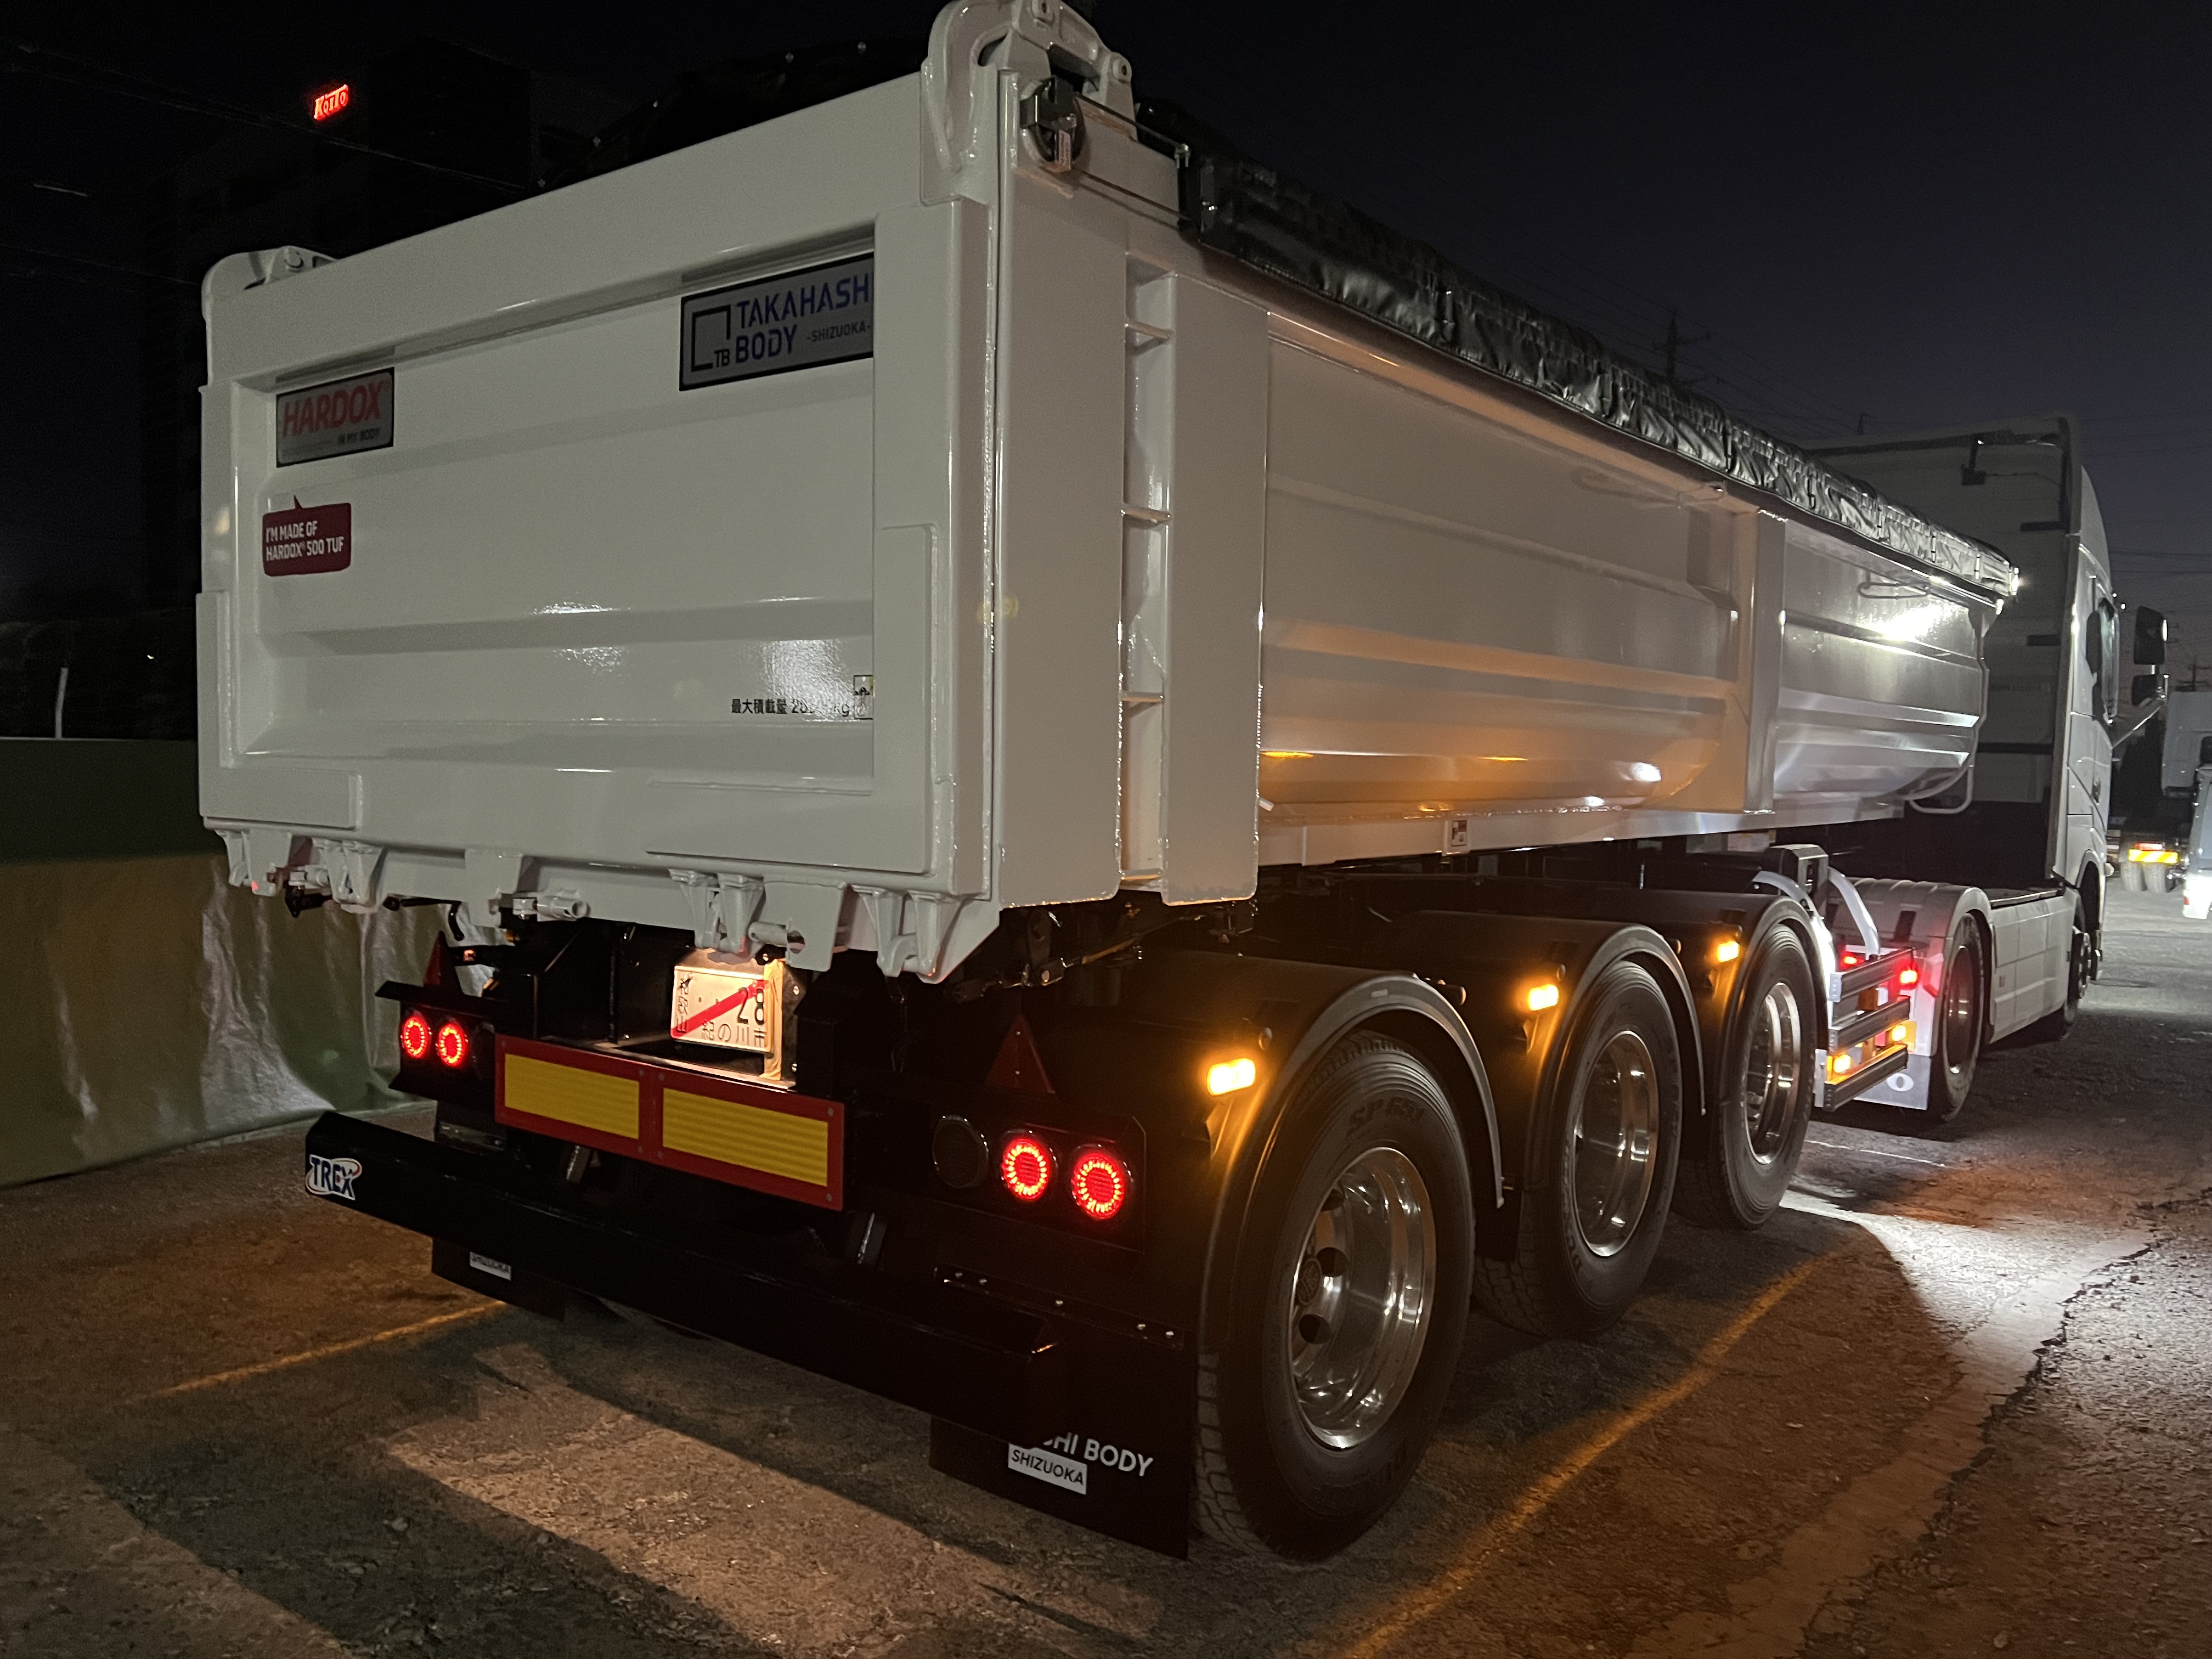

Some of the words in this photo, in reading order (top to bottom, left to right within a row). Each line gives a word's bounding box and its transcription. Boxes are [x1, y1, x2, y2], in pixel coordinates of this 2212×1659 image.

[737, 272, 868, 328] TAKAHASH
[714, 349, 730, 368] TB
[736, 324, 797, 363] BODY
[282, 381, 385, 437] HARDOX
[359, 427, 381, 442] BODY
[266, 527, 278, 543] I'M
[279, 522, 304, 540] MADE
[306, 520, 318, 536] OF
[306, 539, 325, 556] 500
[326, 536, 344, 554] TUF
[311, 1157, 353, 1198] TREX
[1011, 1449, 1084, 1486] SHIZUOKA
[1042, 1432, 1079, 1455] HI
[1084, 1438, 1154, 1477] BODY
